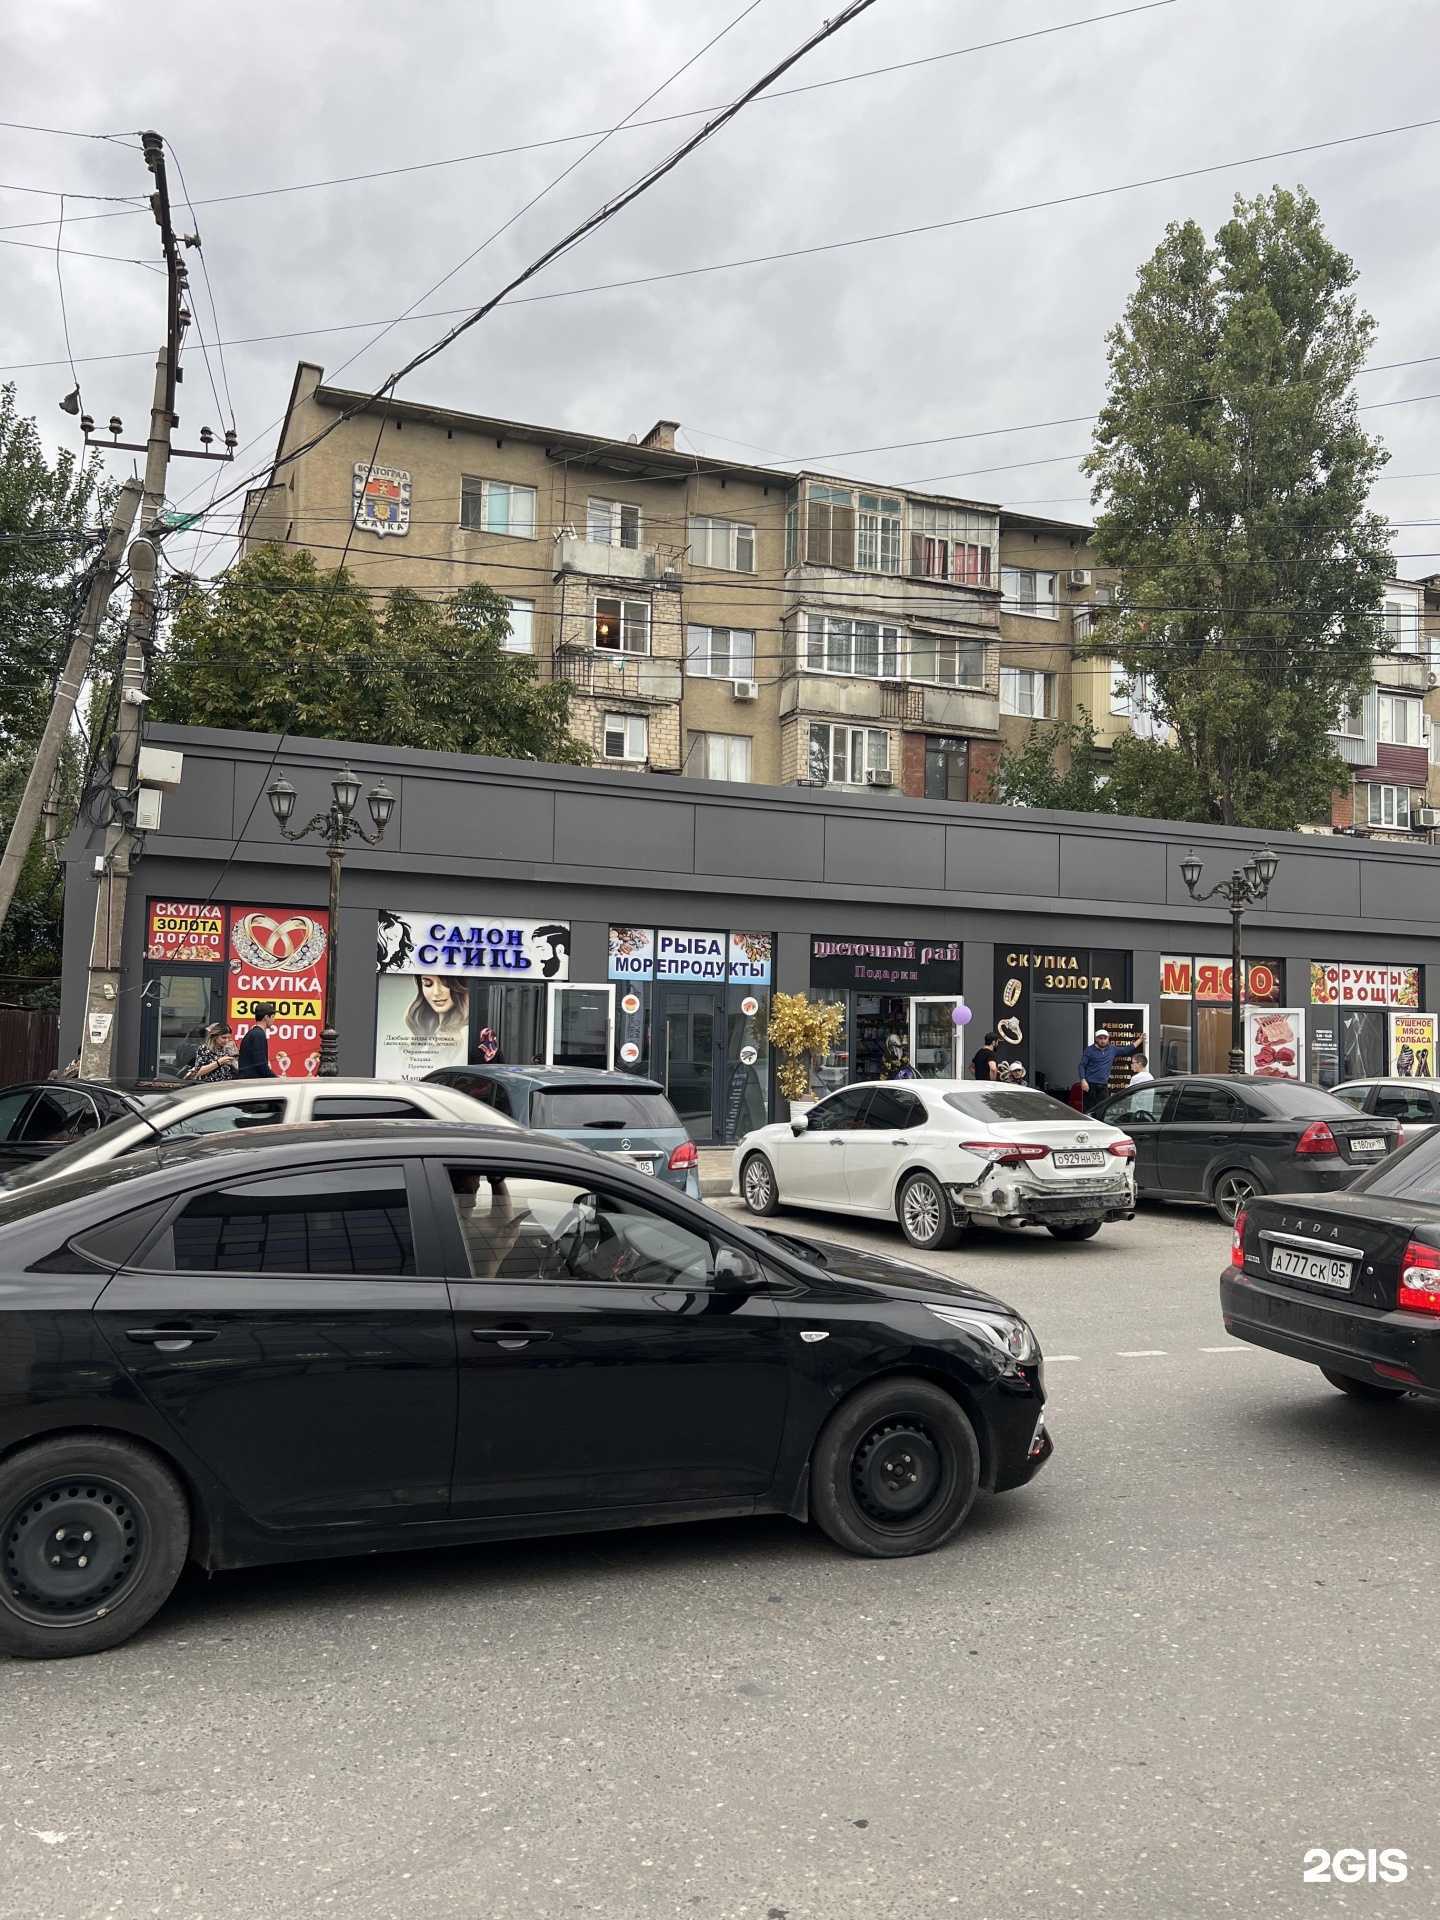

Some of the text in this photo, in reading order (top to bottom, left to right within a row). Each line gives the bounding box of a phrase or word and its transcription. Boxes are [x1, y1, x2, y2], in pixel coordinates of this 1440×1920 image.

[156, 903, 221, 918] СКУПКА
[157, 918, 219, 932] ЗОЛОТА
[155, 932, 219, 945] ДОРОГО
[430, 924, 524, 946] САЛОН
[661, 937, 721, 955] РЫБА
[418, 944, 532, 969] СТИЛЬ
[1006, 953, 1079, 970] СКУПКА
[615, 957, 765, 978] МОРЕПРОДУКТЫ
[855, 965, 918, 982] Подарки
[1327, 968, 1401, 985] ФРУКТЫ
[238, 975, 322, 993] СКУПКА
[1044, 974, 1112, 990] ЗОЛОТА
[1328, 986, 1399, 1004] ОВОЩИ
[235, 1024, 317, 1042] ДРОГО
[1281, 1217, 1339, 1238] LADA
[1275, 1253, 1327, 1280] А777СК
[1331, 1262, 1346, 1279] 05
